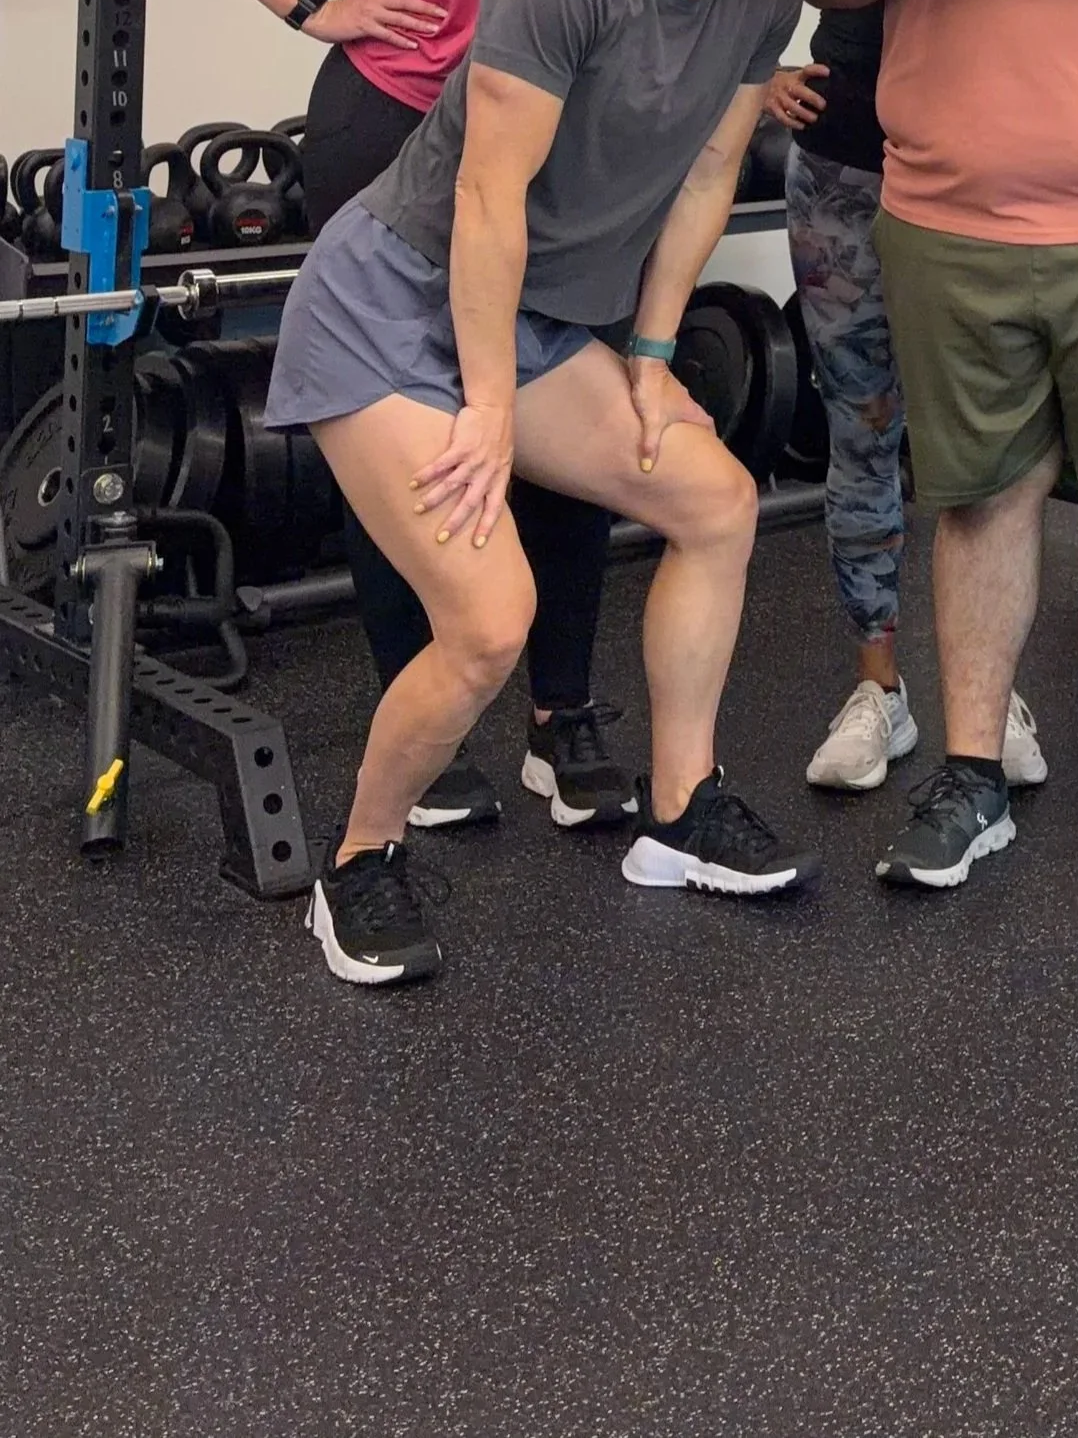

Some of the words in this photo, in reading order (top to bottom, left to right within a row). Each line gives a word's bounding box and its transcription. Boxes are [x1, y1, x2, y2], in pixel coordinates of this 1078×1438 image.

[113, 50, 127, 67] 11
[112, 91, 127, 107] 10
[113, 170, 123, 188] 8
[102, 414, 114, 432] 2
